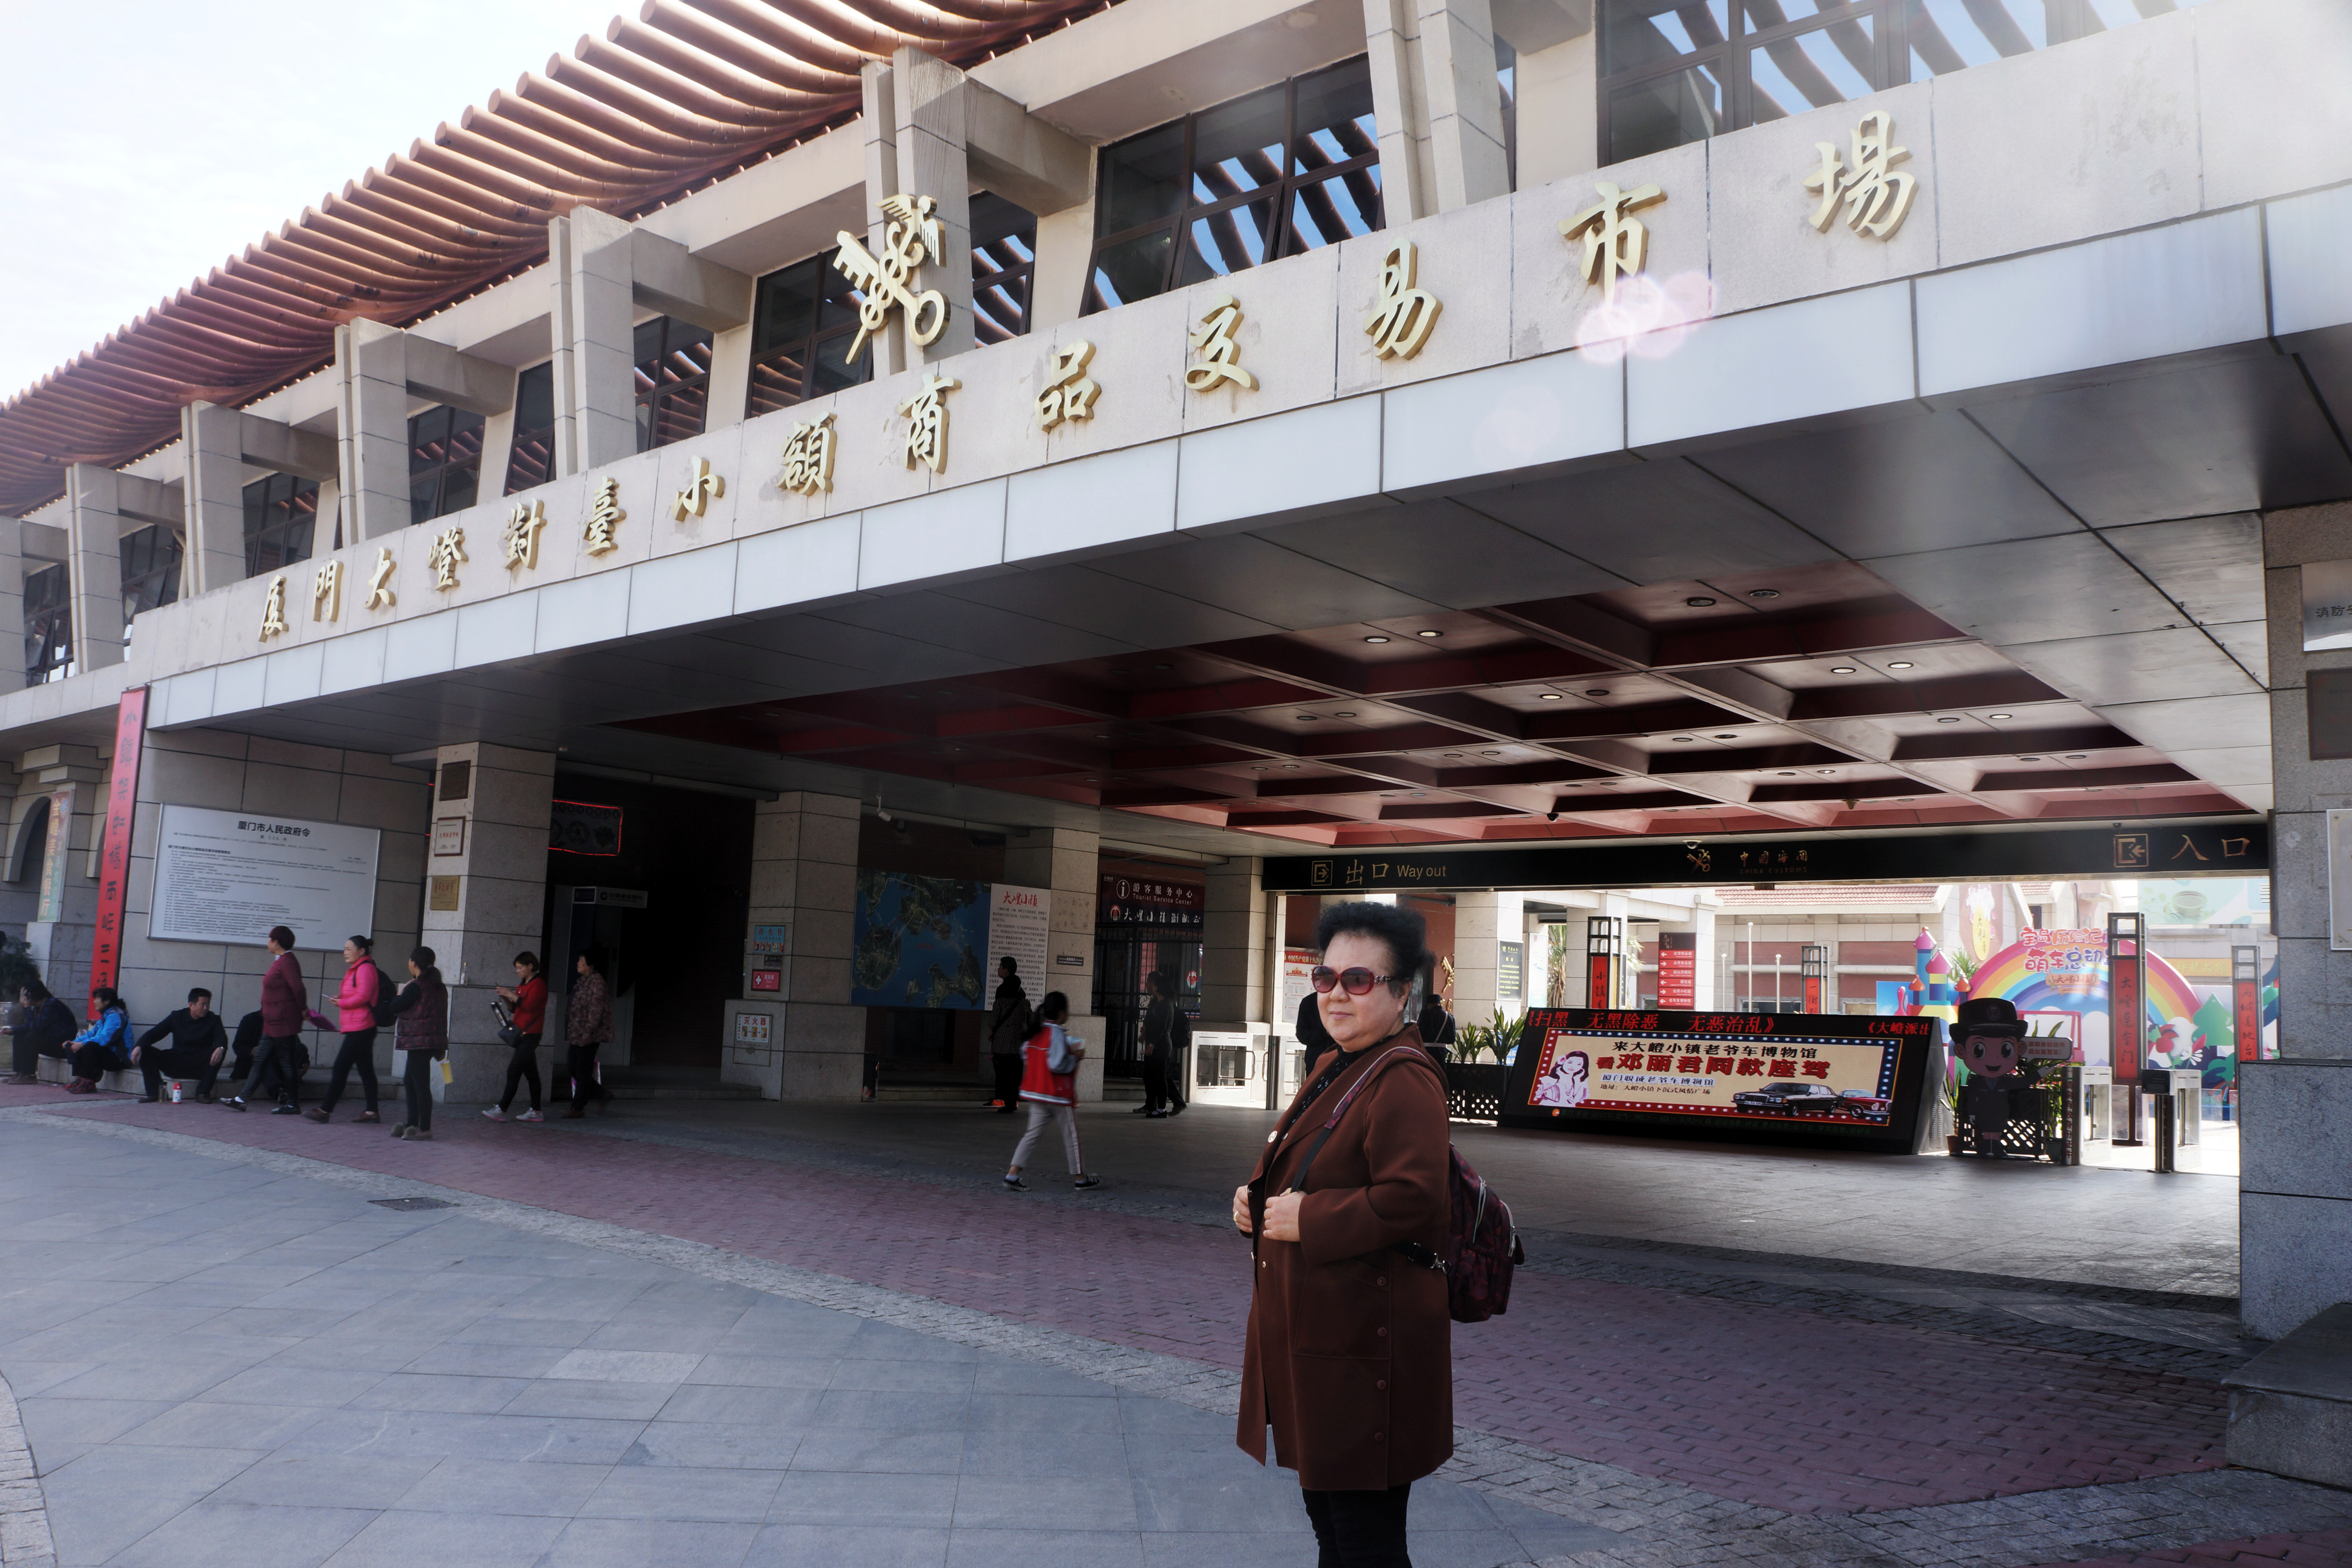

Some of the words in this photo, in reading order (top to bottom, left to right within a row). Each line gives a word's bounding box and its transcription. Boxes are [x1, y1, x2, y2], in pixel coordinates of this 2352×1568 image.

[238, 821, 310, 837] 厦门市人民政府令
[2171, 835, 2250, 861] 入口
[1346, 859, 1389, 885] 出口
[1397, 865, 1423, 880] Way
[1426, 865, 1446, 877] out
[1133, 883, 1193, 898] 游客服务中心
[2020, 926, 2108, 946] 宝岛历险记
[743, 1016, 767, 1026] 灭火器
[1586, 1013, 1659, 1030] 无黑除恶
[1686, 1015, 1775, 1033] 无恶治乱》
[1612, 1041, 1818, 1059] 来大嶝小镇老爷车博物馆
[1595, 1053, 1831, 1080] 看邓丽君同款座驾
